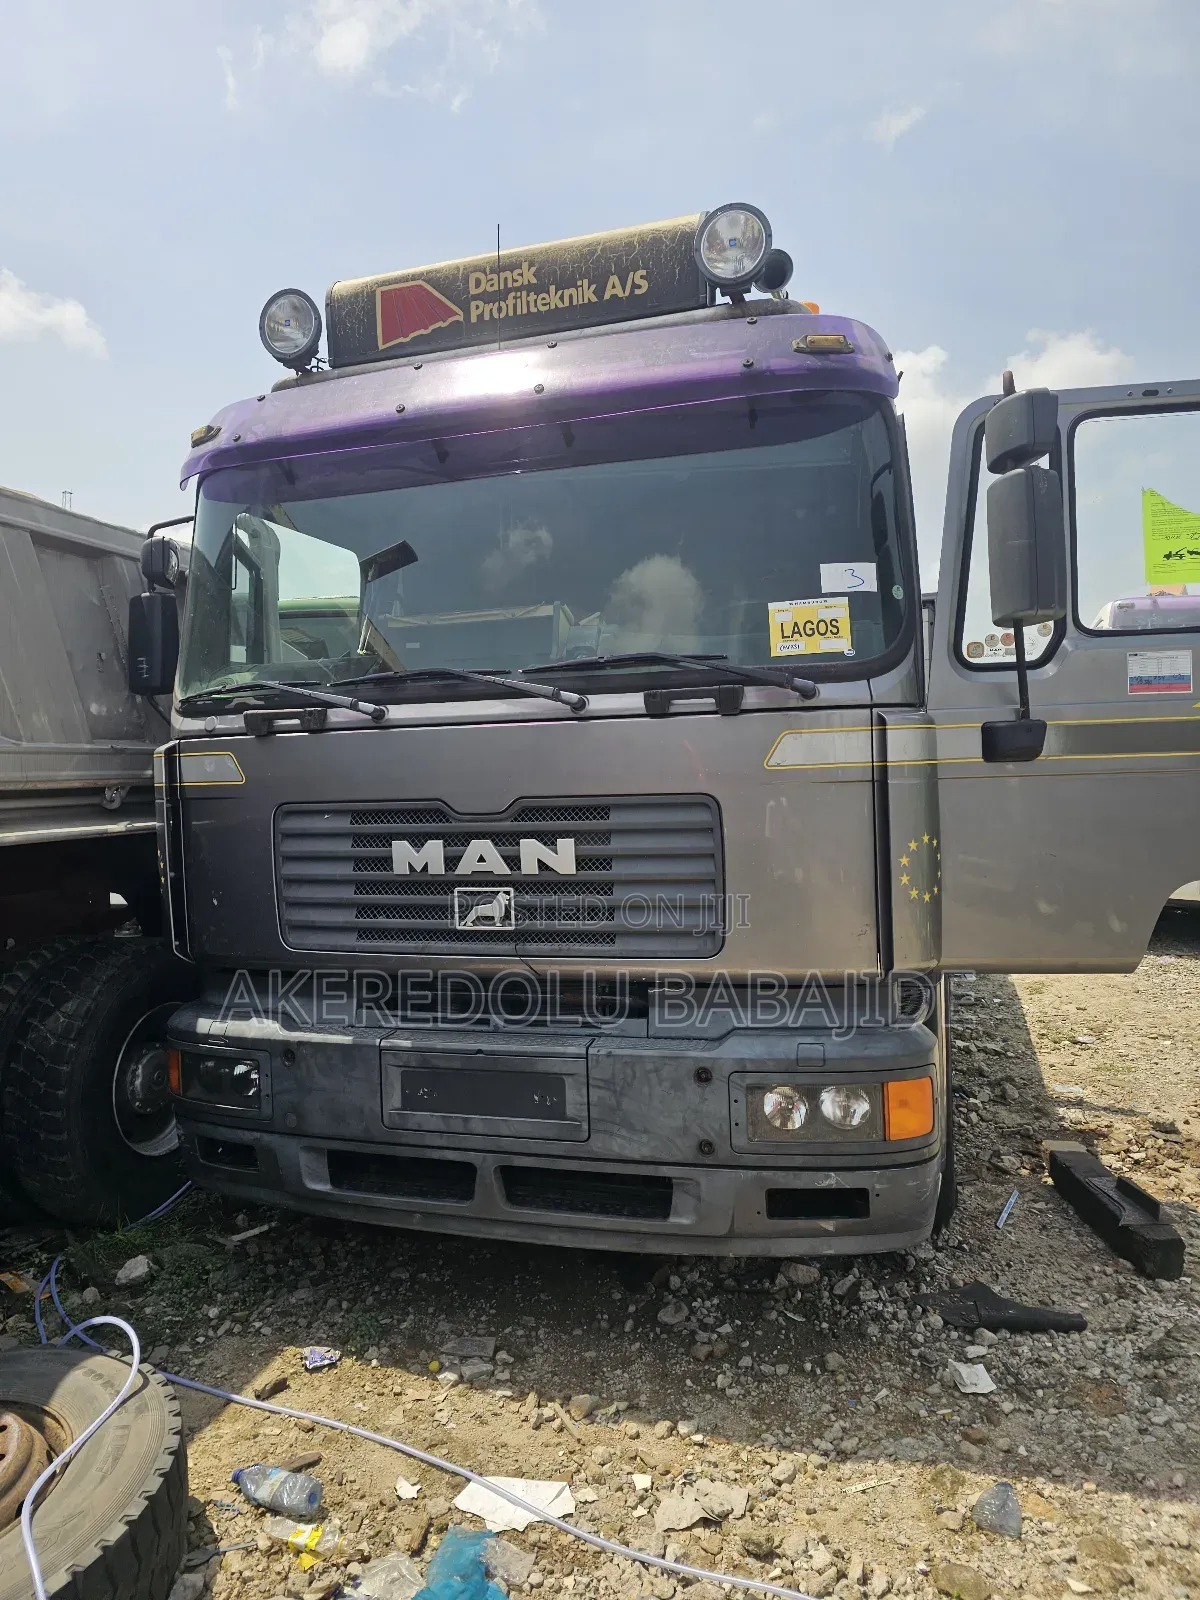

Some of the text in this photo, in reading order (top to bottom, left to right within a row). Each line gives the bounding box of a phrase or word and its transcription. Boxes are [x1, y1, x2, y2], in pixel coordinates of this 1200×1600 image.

[468, 261, 538, 295] Dansk
[470, 269, 650, 323] Profilteknik A/S
[844, 567, 866, 589] 3
[780, 617, 841, 640] LAGOS
[391, 837, 577, 875] MAN
